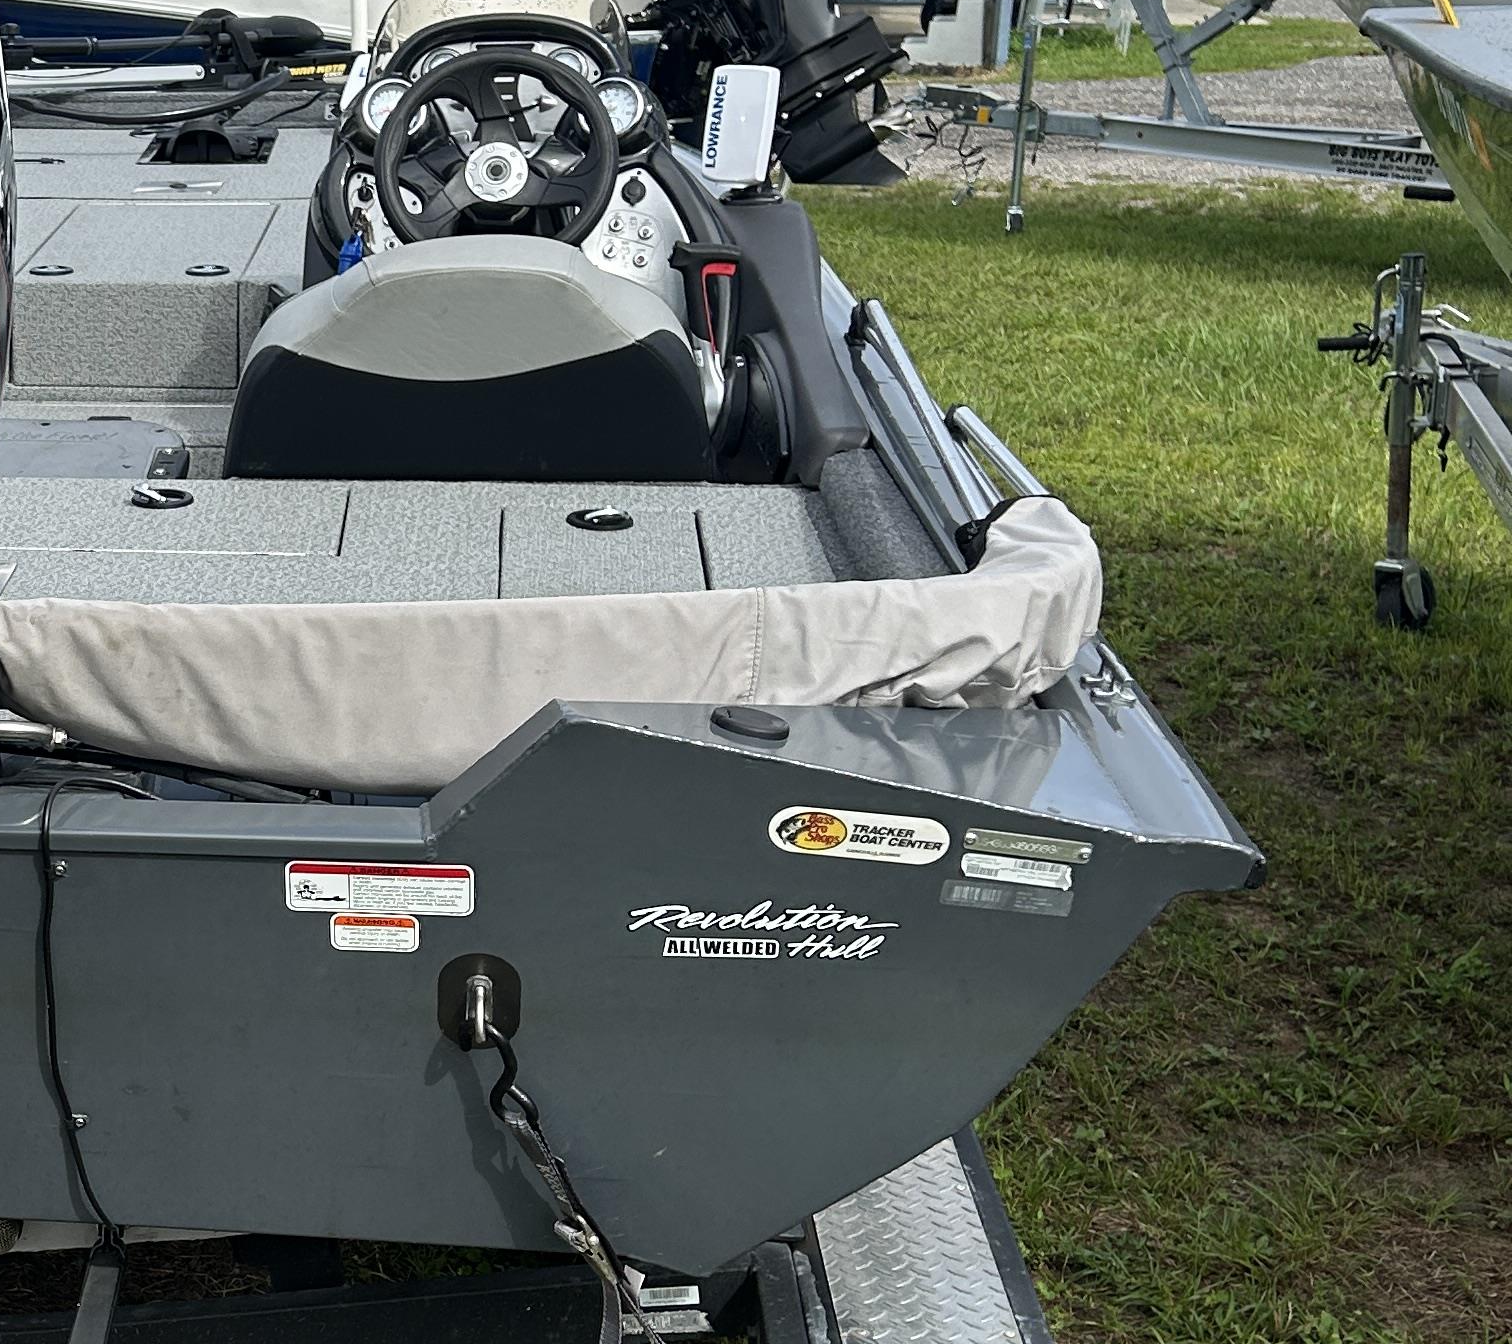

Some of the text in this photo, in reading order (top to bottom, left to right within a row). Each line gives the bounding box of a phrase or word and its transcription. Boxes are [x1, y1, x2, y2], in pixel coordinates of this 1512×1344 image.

[704, 74, 728, 169] LOWRANCE
[849, 834, 944, 852] BOAT CENTER
[852, 823, 916, 838] TRACKER
[626, 899, 900, 933] Revolution
[665, 933, 886, 960] ALL WELDED Hull
